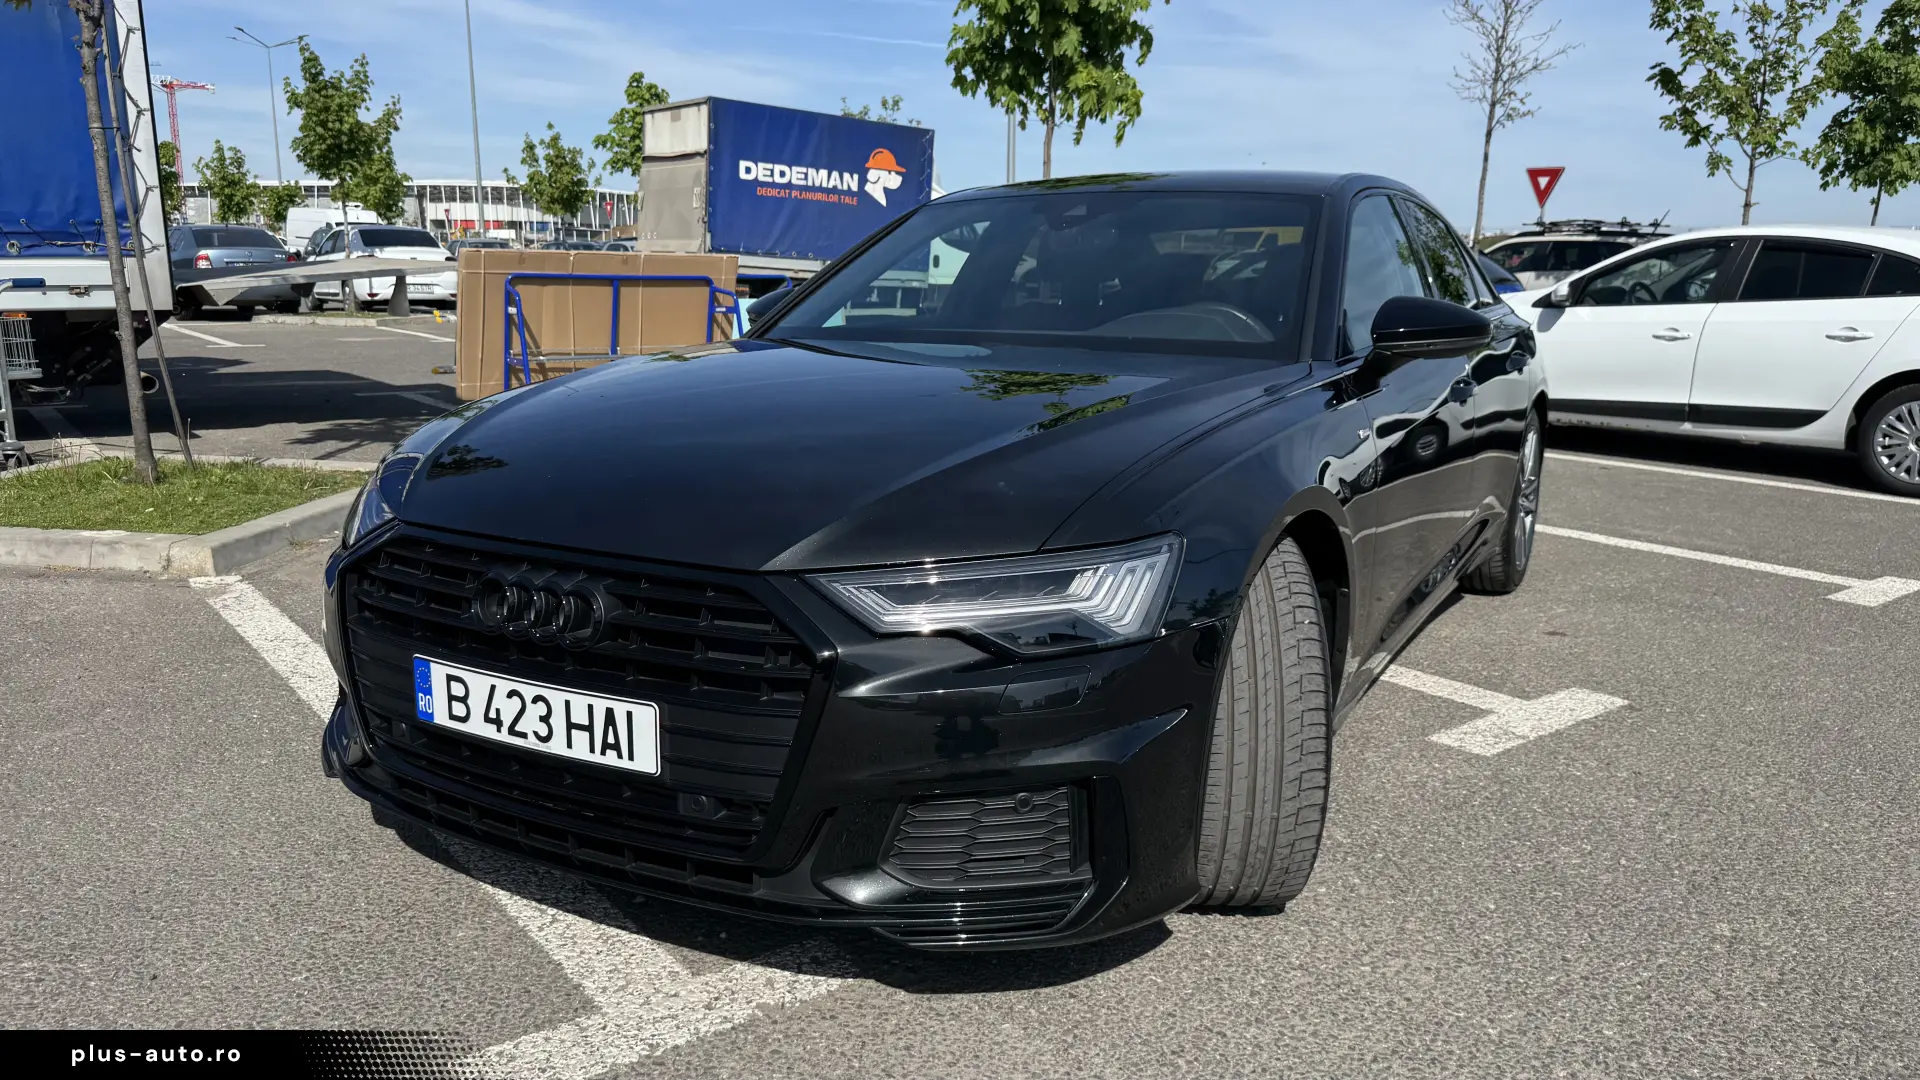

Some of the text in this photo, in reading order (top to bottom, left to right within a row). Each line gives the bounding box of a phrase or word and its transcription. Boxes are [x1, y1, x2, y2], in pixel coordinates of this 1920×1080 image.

[739, 160, 859, 191] DEDEMAN
[757, 187, 858, 205] DEDICAT PLANURILOR TALE
[418, 692, 433, 713] RO
[445, 673, 635, 762] B 423 HAI
